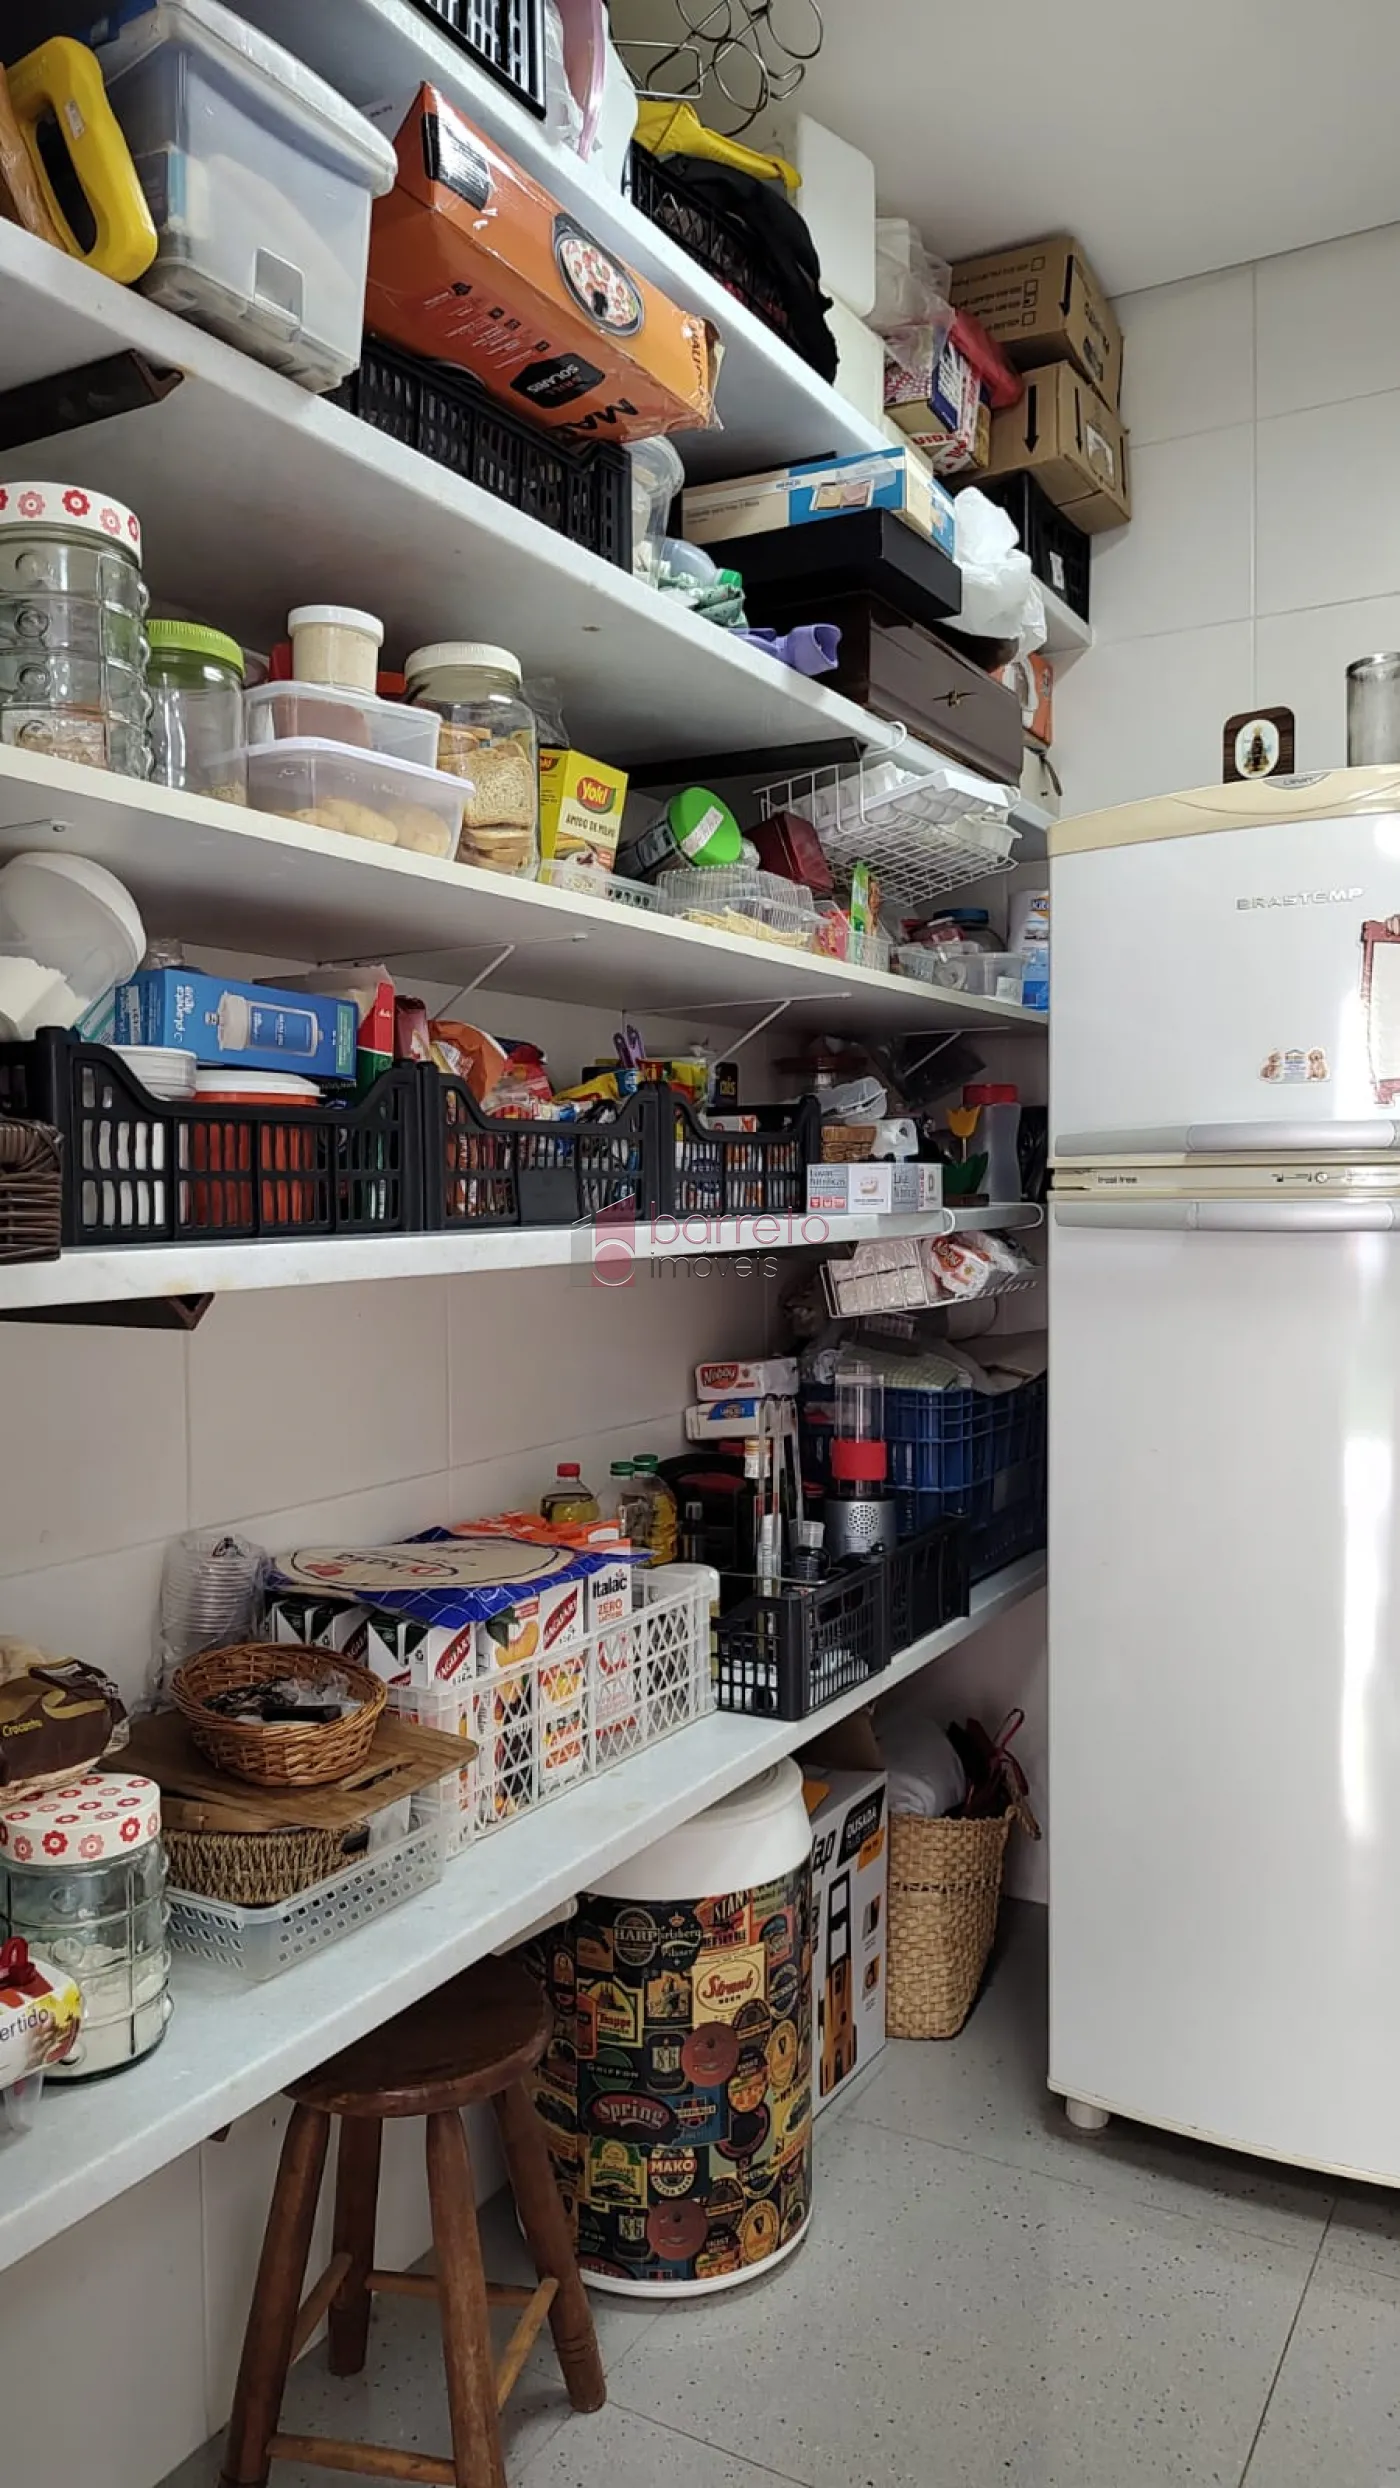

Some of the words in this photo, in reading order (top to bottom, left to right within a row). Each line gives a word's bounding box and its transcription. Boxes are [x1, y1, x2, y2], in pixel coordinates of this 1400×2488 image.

[526, 363, 580, 393] SOLARIS
[1235, 886, 1364, 911] BRASTEMP
[592, 1575, 628, 1599] Italac
[597, 1598, 623, 1615] ZERO
[846, 1805, 877, 1839] OUSADA
[615, 1927, 659, 1942] HARP
[599, 2101, 664, 2131] Spring
[651, 2160, 695, 2173] MAKO
